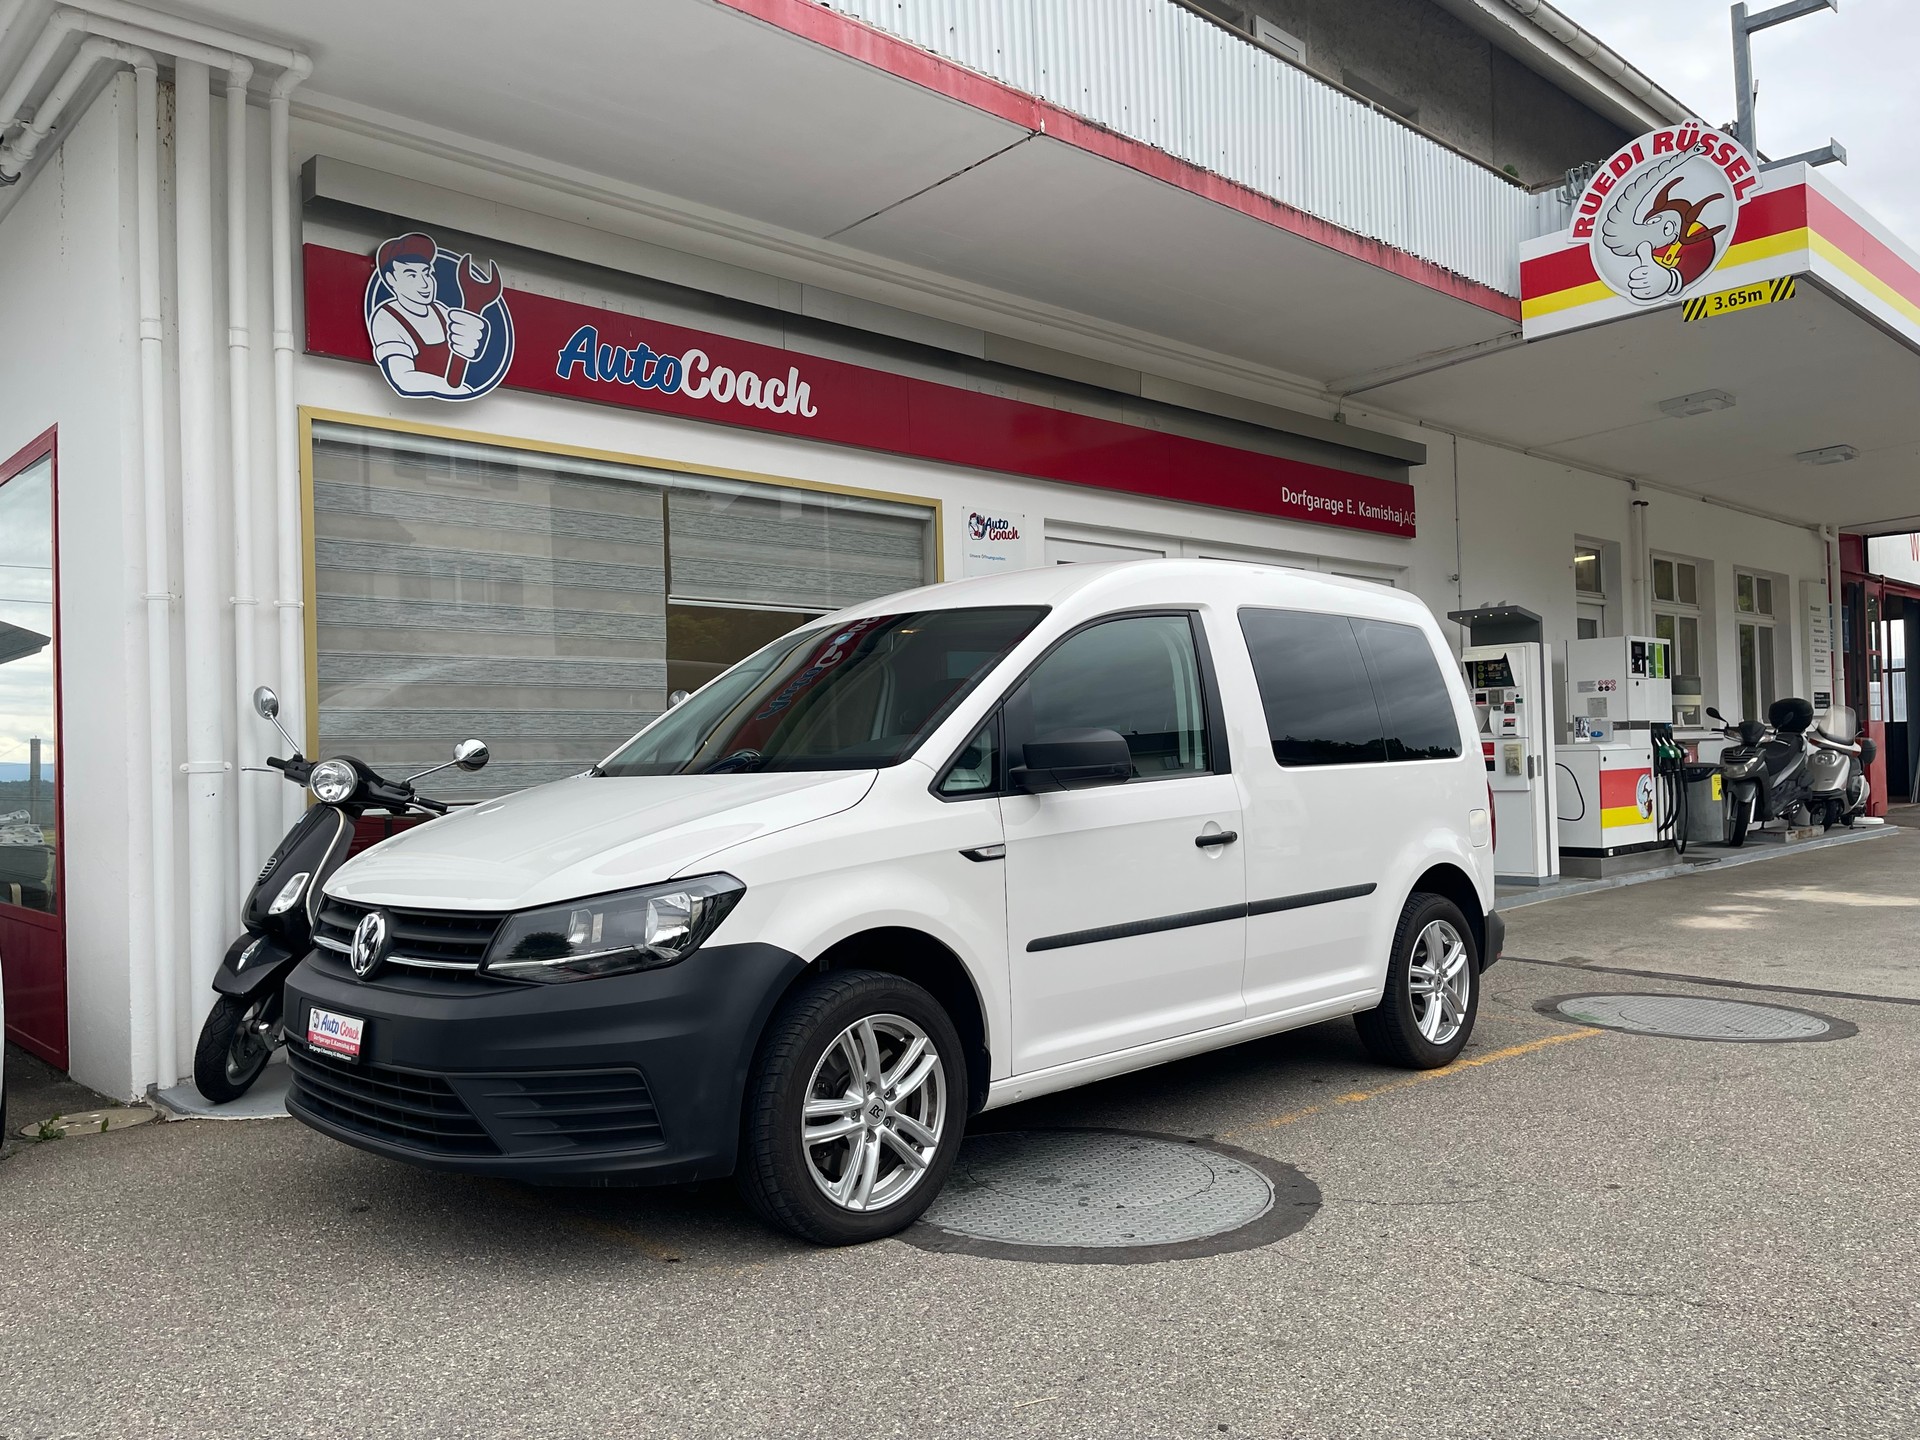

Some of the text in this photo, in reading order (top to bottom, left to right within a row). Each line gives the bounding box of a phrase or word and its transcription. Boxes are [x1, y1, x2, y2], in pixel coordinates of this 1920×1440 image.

[1572, 121, 1757, 239] RUEDI RÜSSEL
[1713, 288, 1764, 311] 3.65m
[1281, 486, 1416, 527] Dorfgarage E. Kamishaj AG
[985, 517, 1009, 530] Auto
[988, 526, 1020, 541] Coach
[1638, 659, 1643, 672] 1
[321, 1014, 360, 1040] Auto Coach
[868, 1104, 883, 1119] RC
